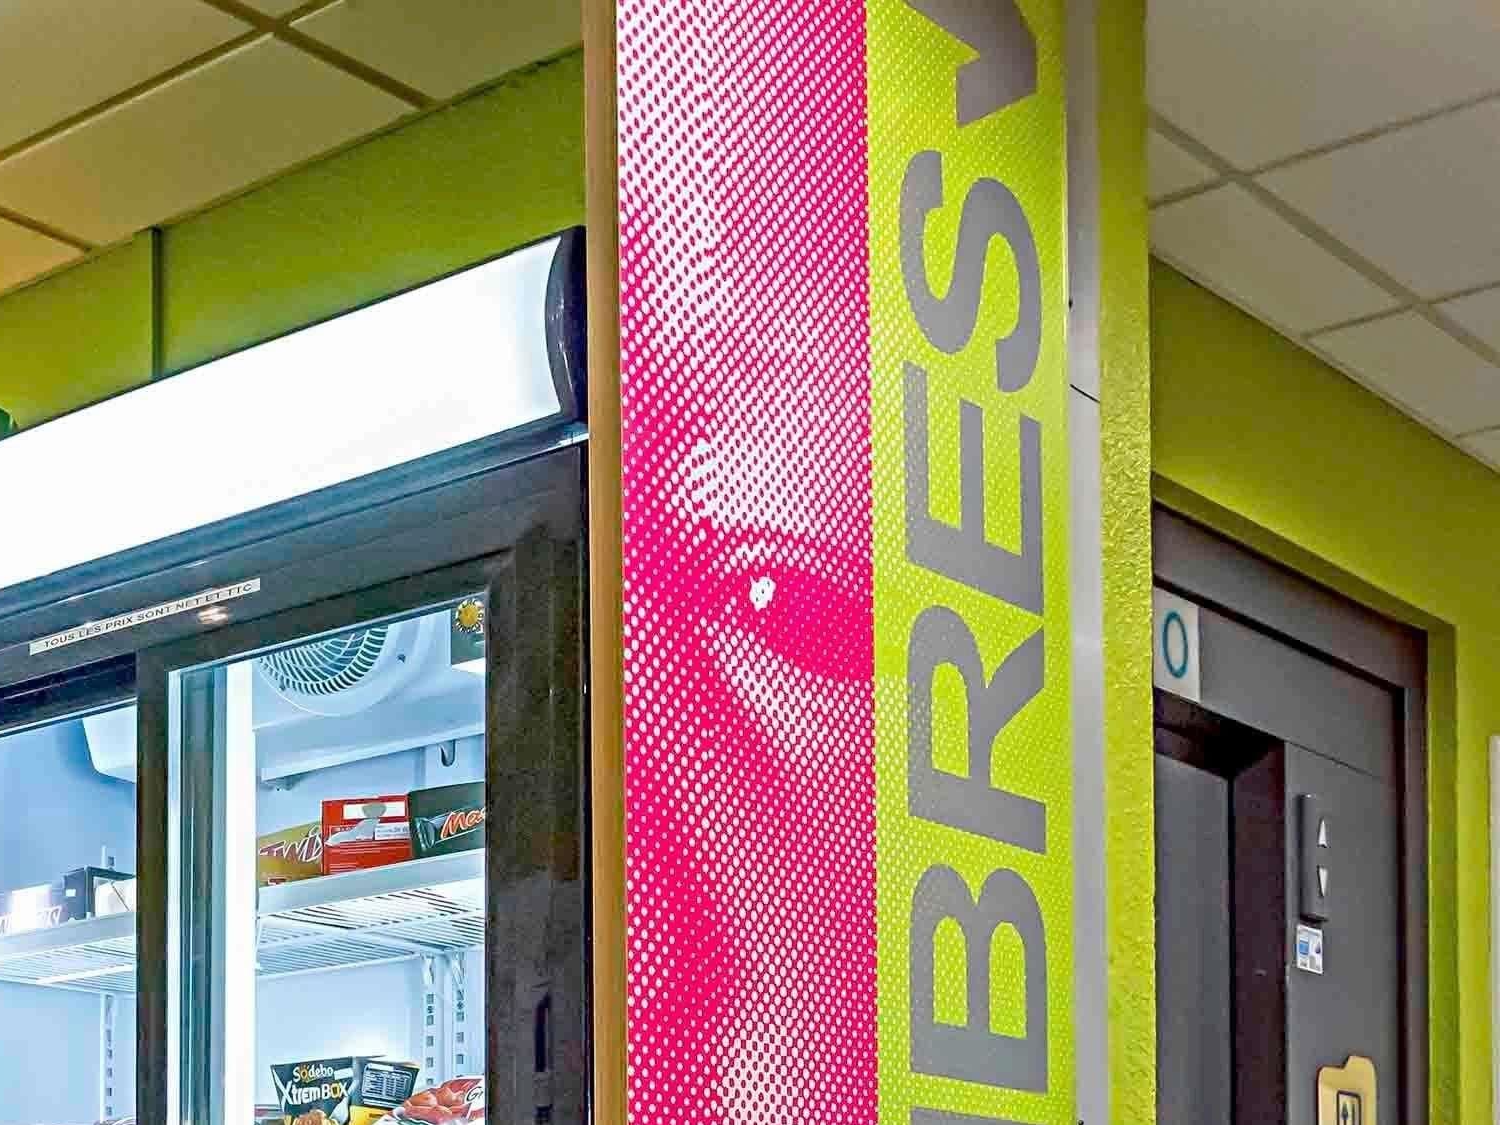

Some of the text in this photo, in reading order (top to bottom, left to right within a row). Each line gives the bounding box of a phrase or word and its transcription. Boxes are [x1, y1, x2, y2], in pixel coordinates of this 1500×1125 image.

[43, 628, 75, 648] TOUS
[79, 624, 102, 638] LES
[105, 615, 134, 632] PRIX
[136, 605, 172, 621] SONT
[205, 591, 222, 602] ET
